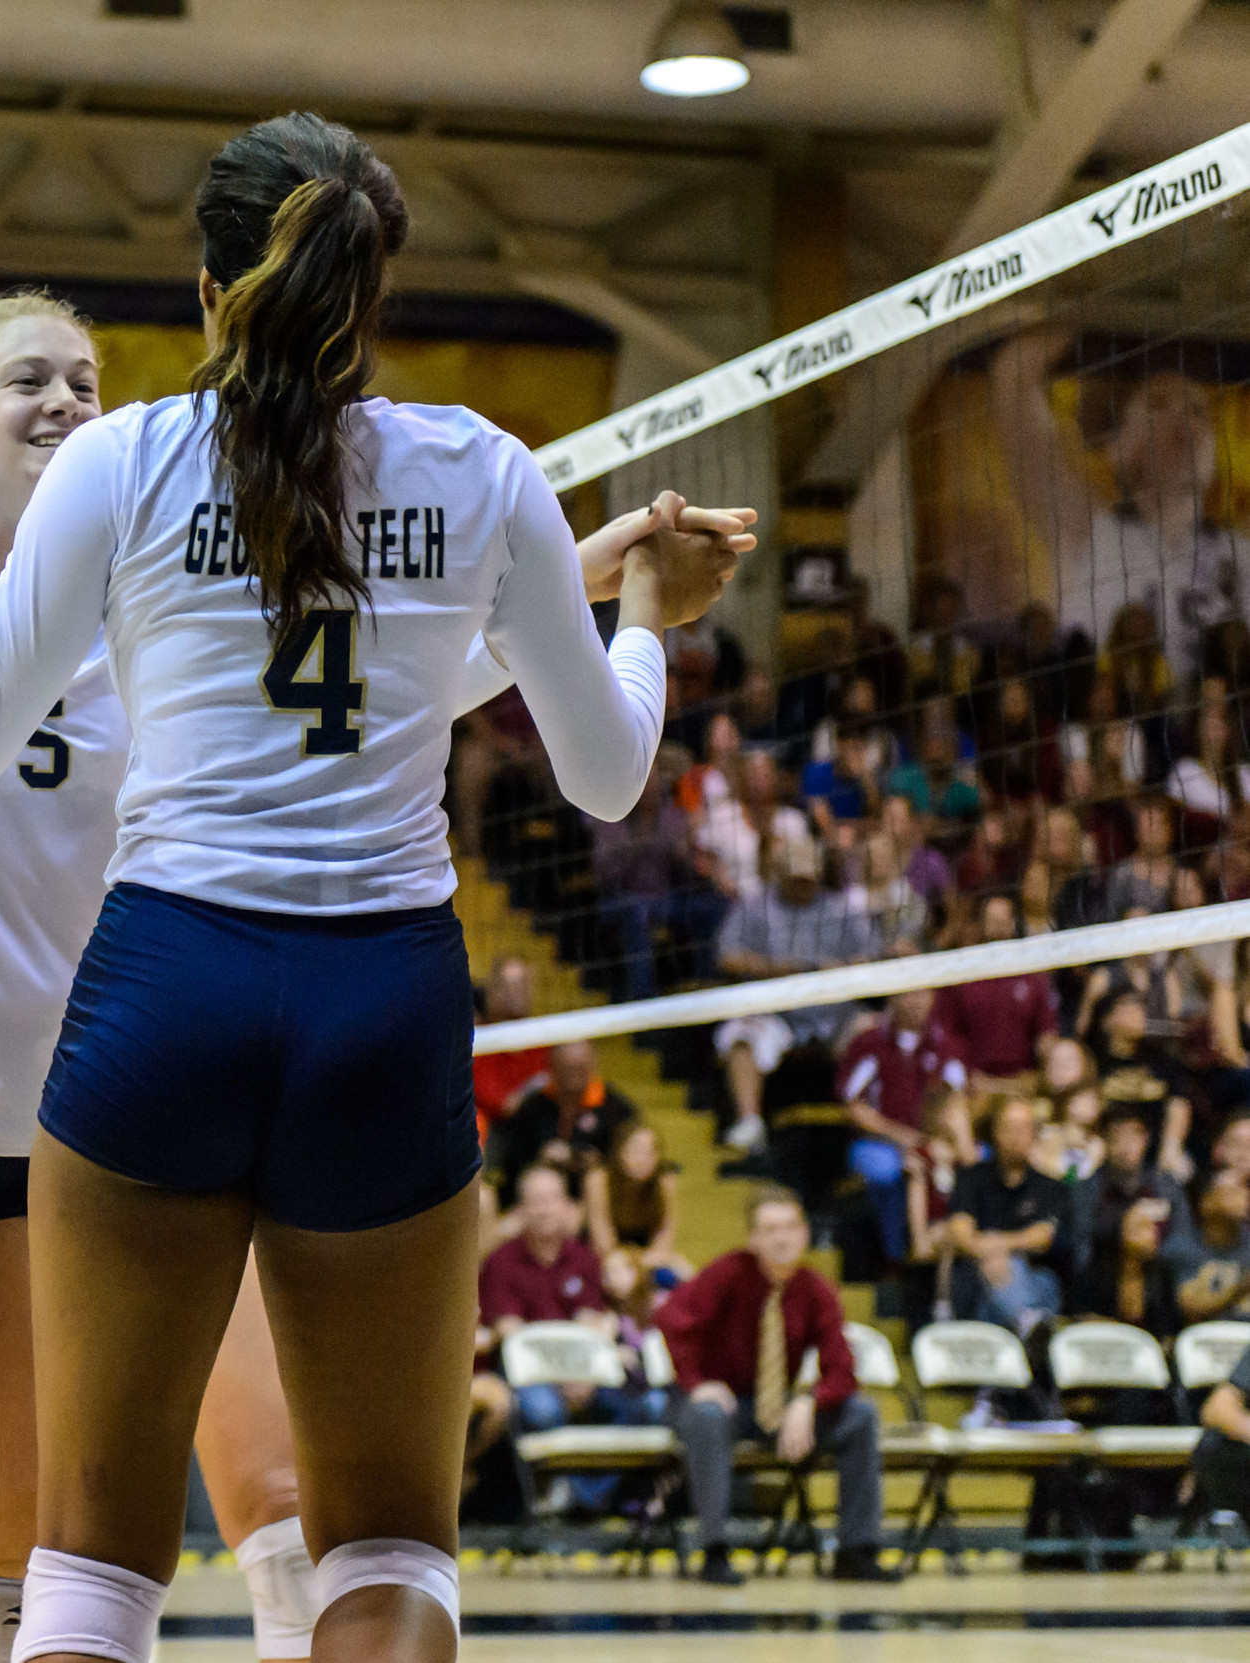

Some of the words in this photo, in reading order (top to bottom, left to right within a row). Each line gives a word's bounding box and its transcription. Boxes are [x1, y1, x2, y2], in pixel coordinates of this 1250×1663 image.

[357, 507, 444, 578] TECH
[258, 609, 369, 758] 4
[16, 696, 73, 792] 5
